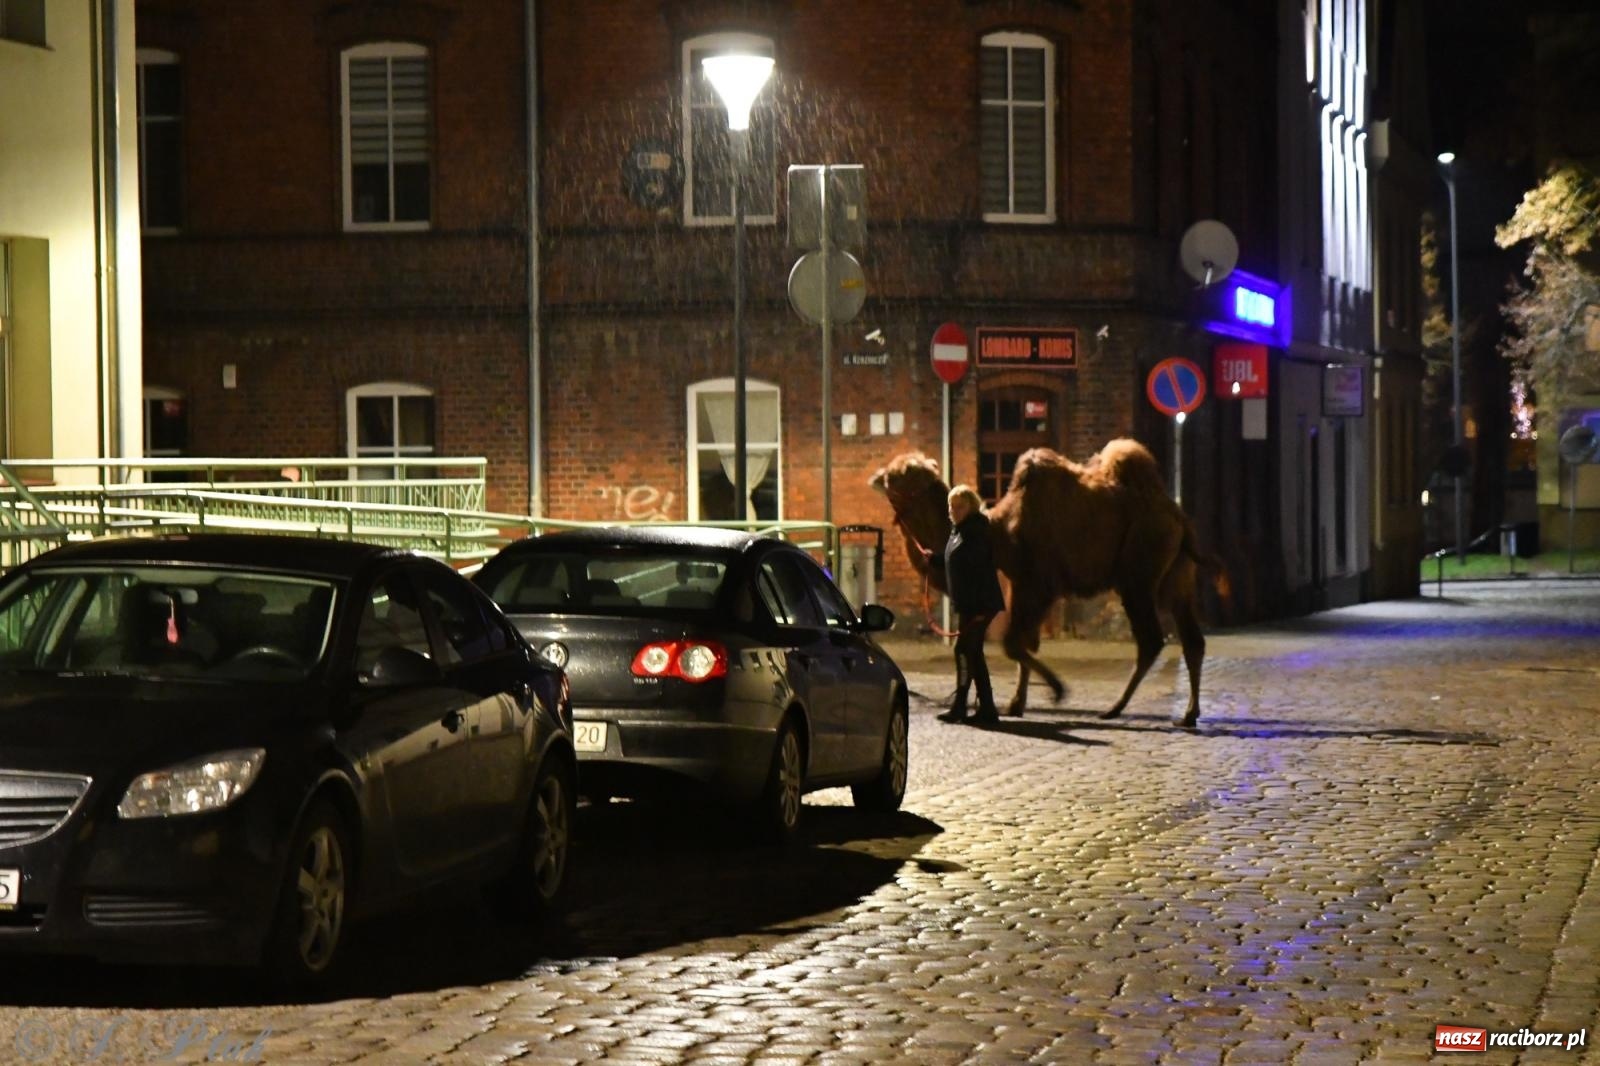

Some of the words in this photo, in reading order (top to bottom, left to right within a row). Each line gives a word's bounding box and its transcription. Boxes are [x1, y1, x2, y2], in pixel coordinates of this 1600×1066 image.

[981, 337, 1031, 359] LOMBARD
[1038, 338, 1073, 359] KOMIS
[577, 726, 600, 744] 20
